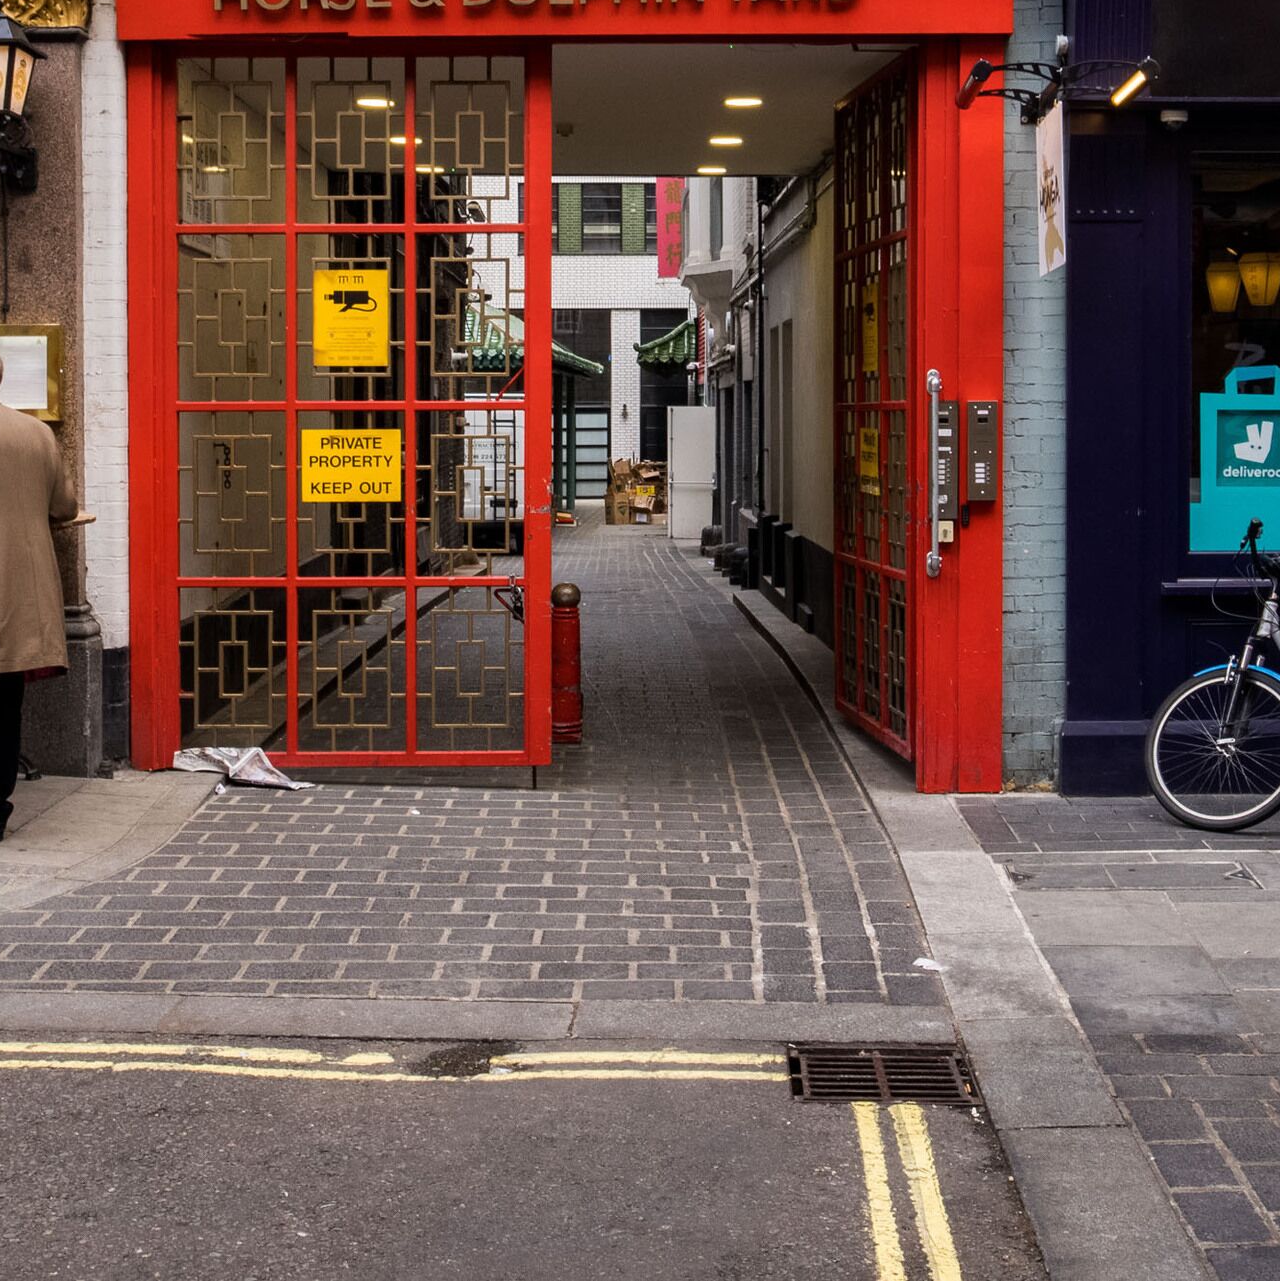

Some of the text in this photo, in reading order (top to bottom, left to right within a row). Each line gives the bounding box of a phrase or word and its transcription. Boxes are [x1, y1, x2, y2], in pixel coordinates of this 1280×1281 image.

[320, 437, 382, 449] PRIVATE
[309, 455, 393, 468] PROPERTY
[311, 481, 392, 495] KEEP OUT
